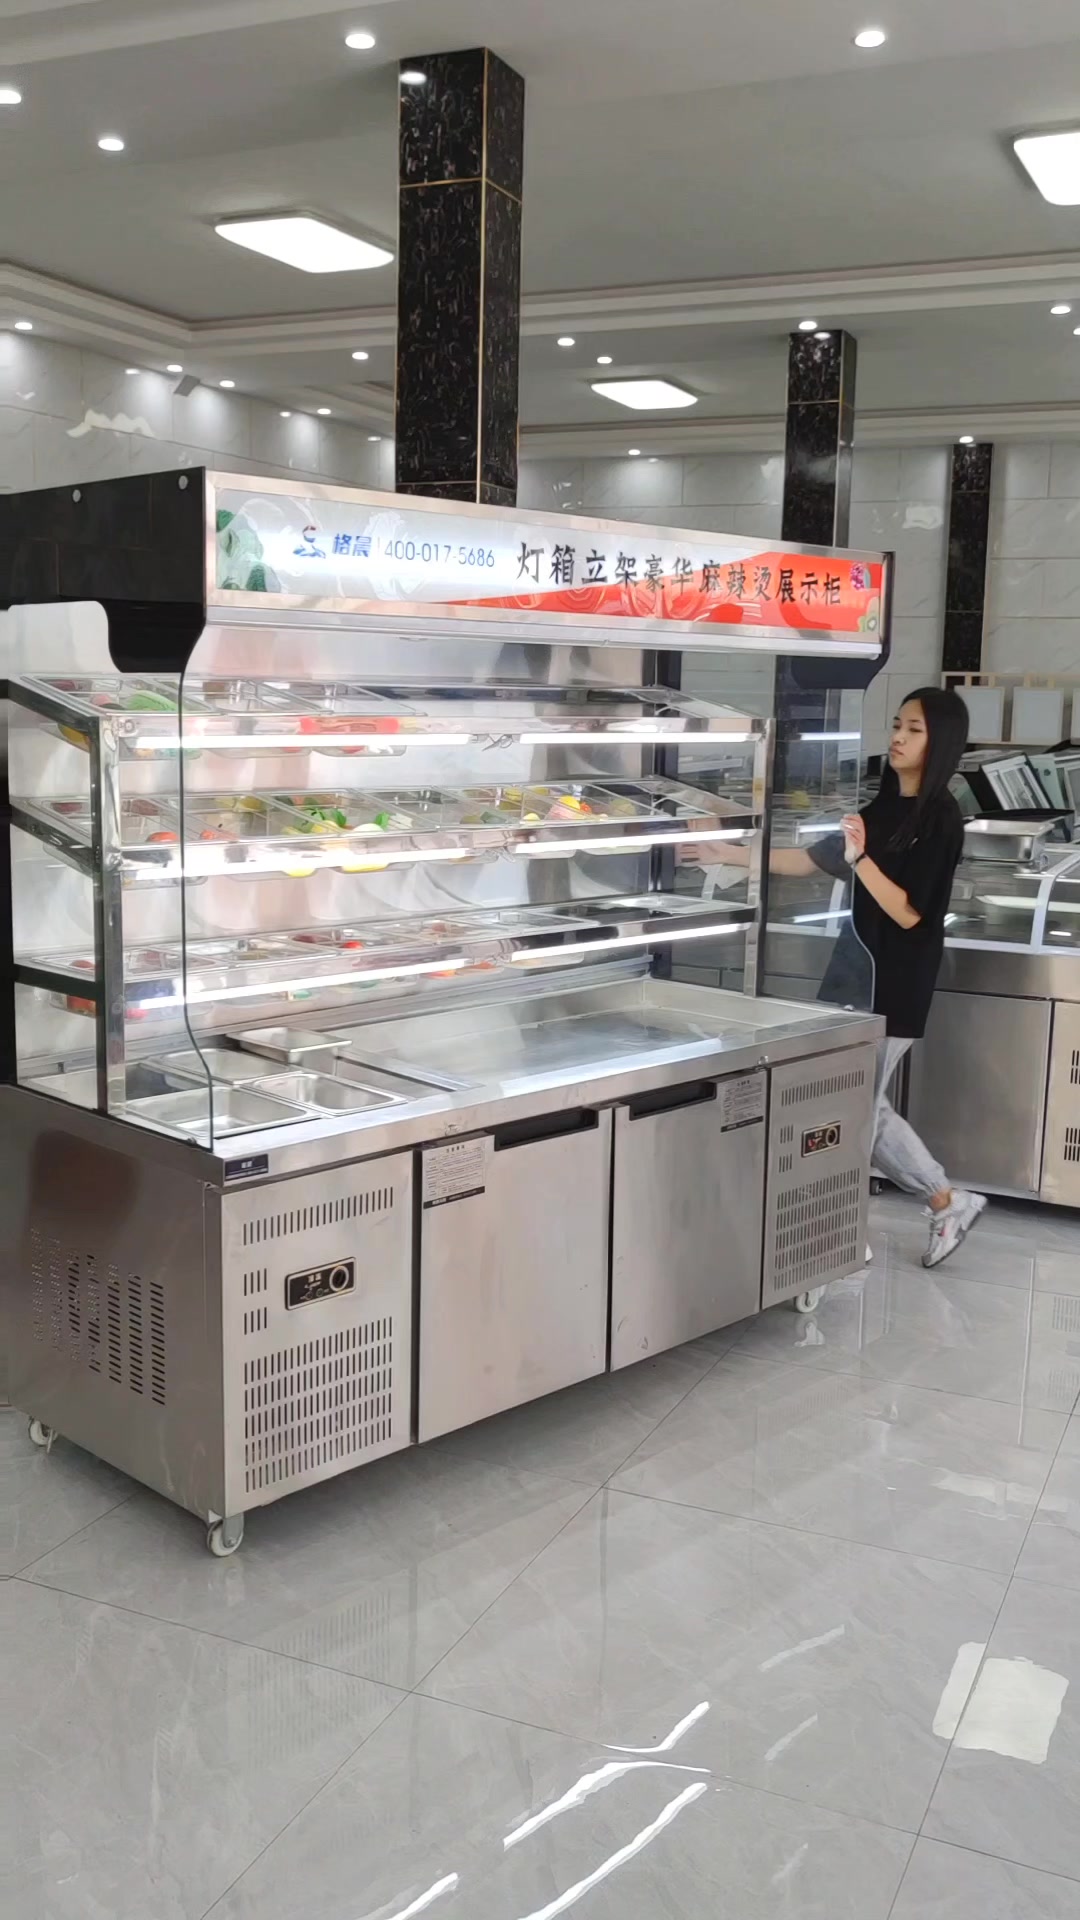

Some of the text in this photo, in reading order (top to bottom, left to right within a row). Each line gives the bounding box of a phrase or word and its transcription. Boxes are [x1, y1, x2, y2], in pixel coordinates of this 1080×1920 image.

[332, 533, 372, 557] 格晨
[384, 540, 495, 567] 400-017-5686
[516, 542, 840, 605] 灯箱立架豪华麻辣烫展示柜
